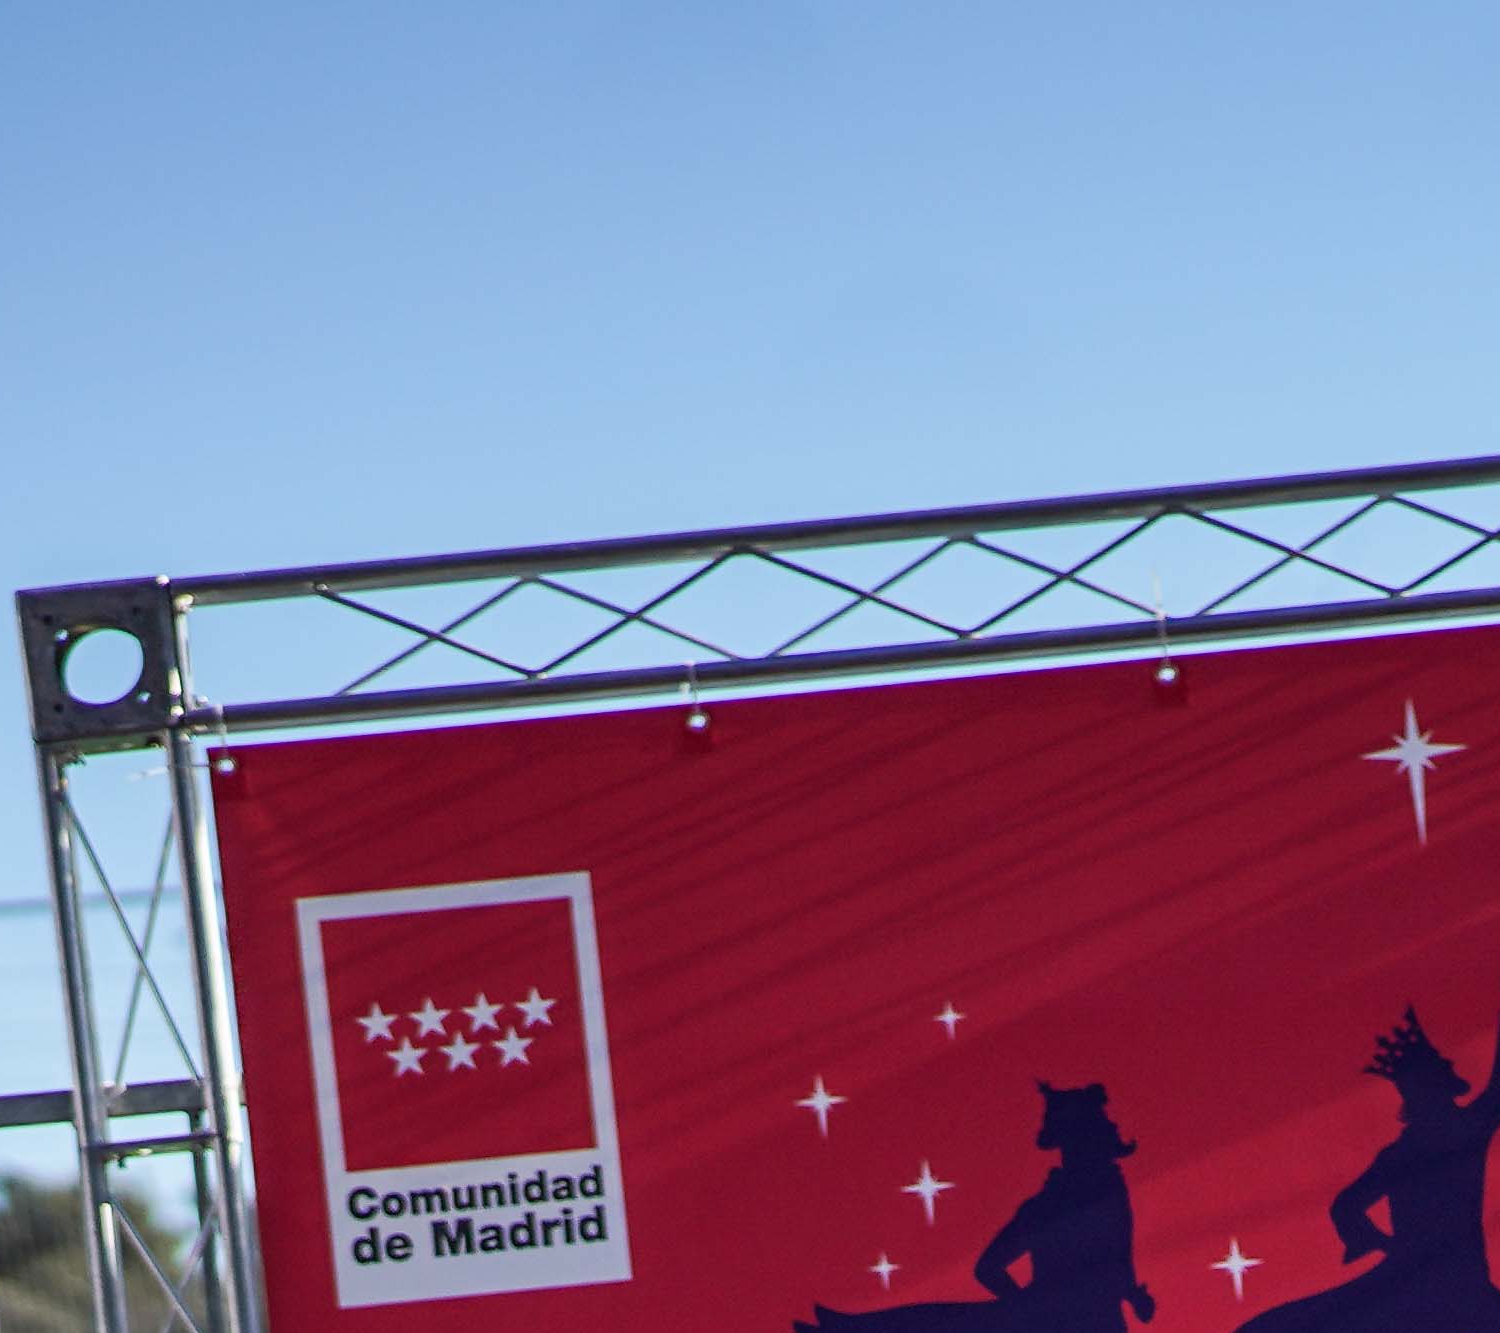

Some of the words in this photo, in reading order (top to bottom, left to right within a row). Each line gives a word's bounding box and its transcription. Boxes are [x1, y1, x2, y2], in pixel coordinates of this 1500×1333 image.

[346, 1164, 605, 1220] Comunidad
[352, 1227, 414, 1265] de
[432, 1206, 609, 1258] Madrid
